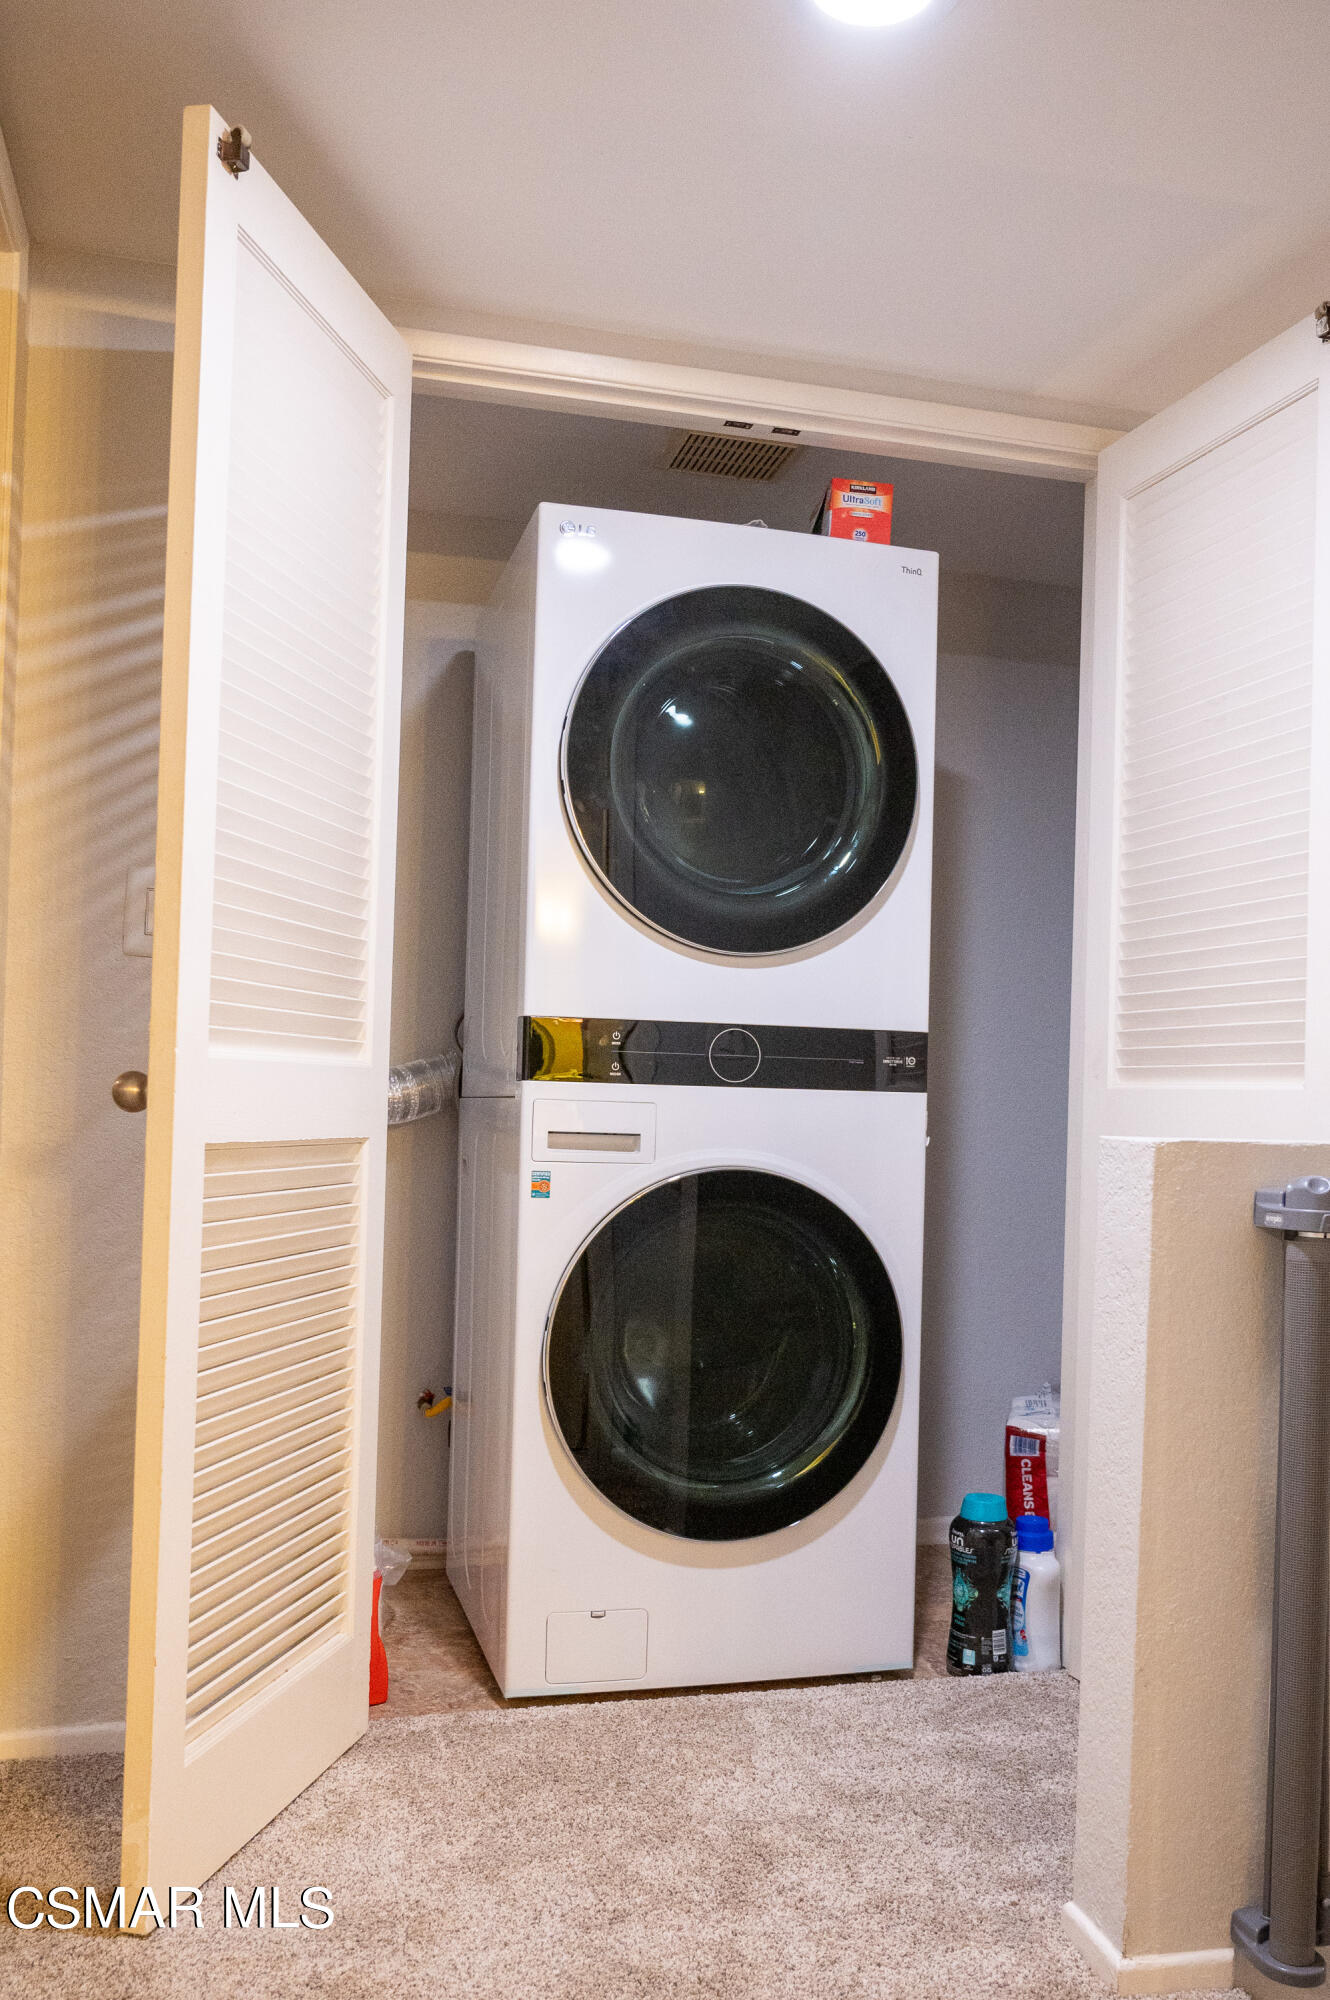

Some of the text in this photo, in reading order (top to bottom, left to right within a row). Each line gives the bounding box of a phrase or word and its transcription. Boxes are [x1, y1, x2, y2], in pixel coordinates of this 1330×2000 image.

[842, 494, 882, 506] UltraSoft
[902, 566, 922, 576] ThinQ
[1021, 1458, 1035, 1509] CLEANS
